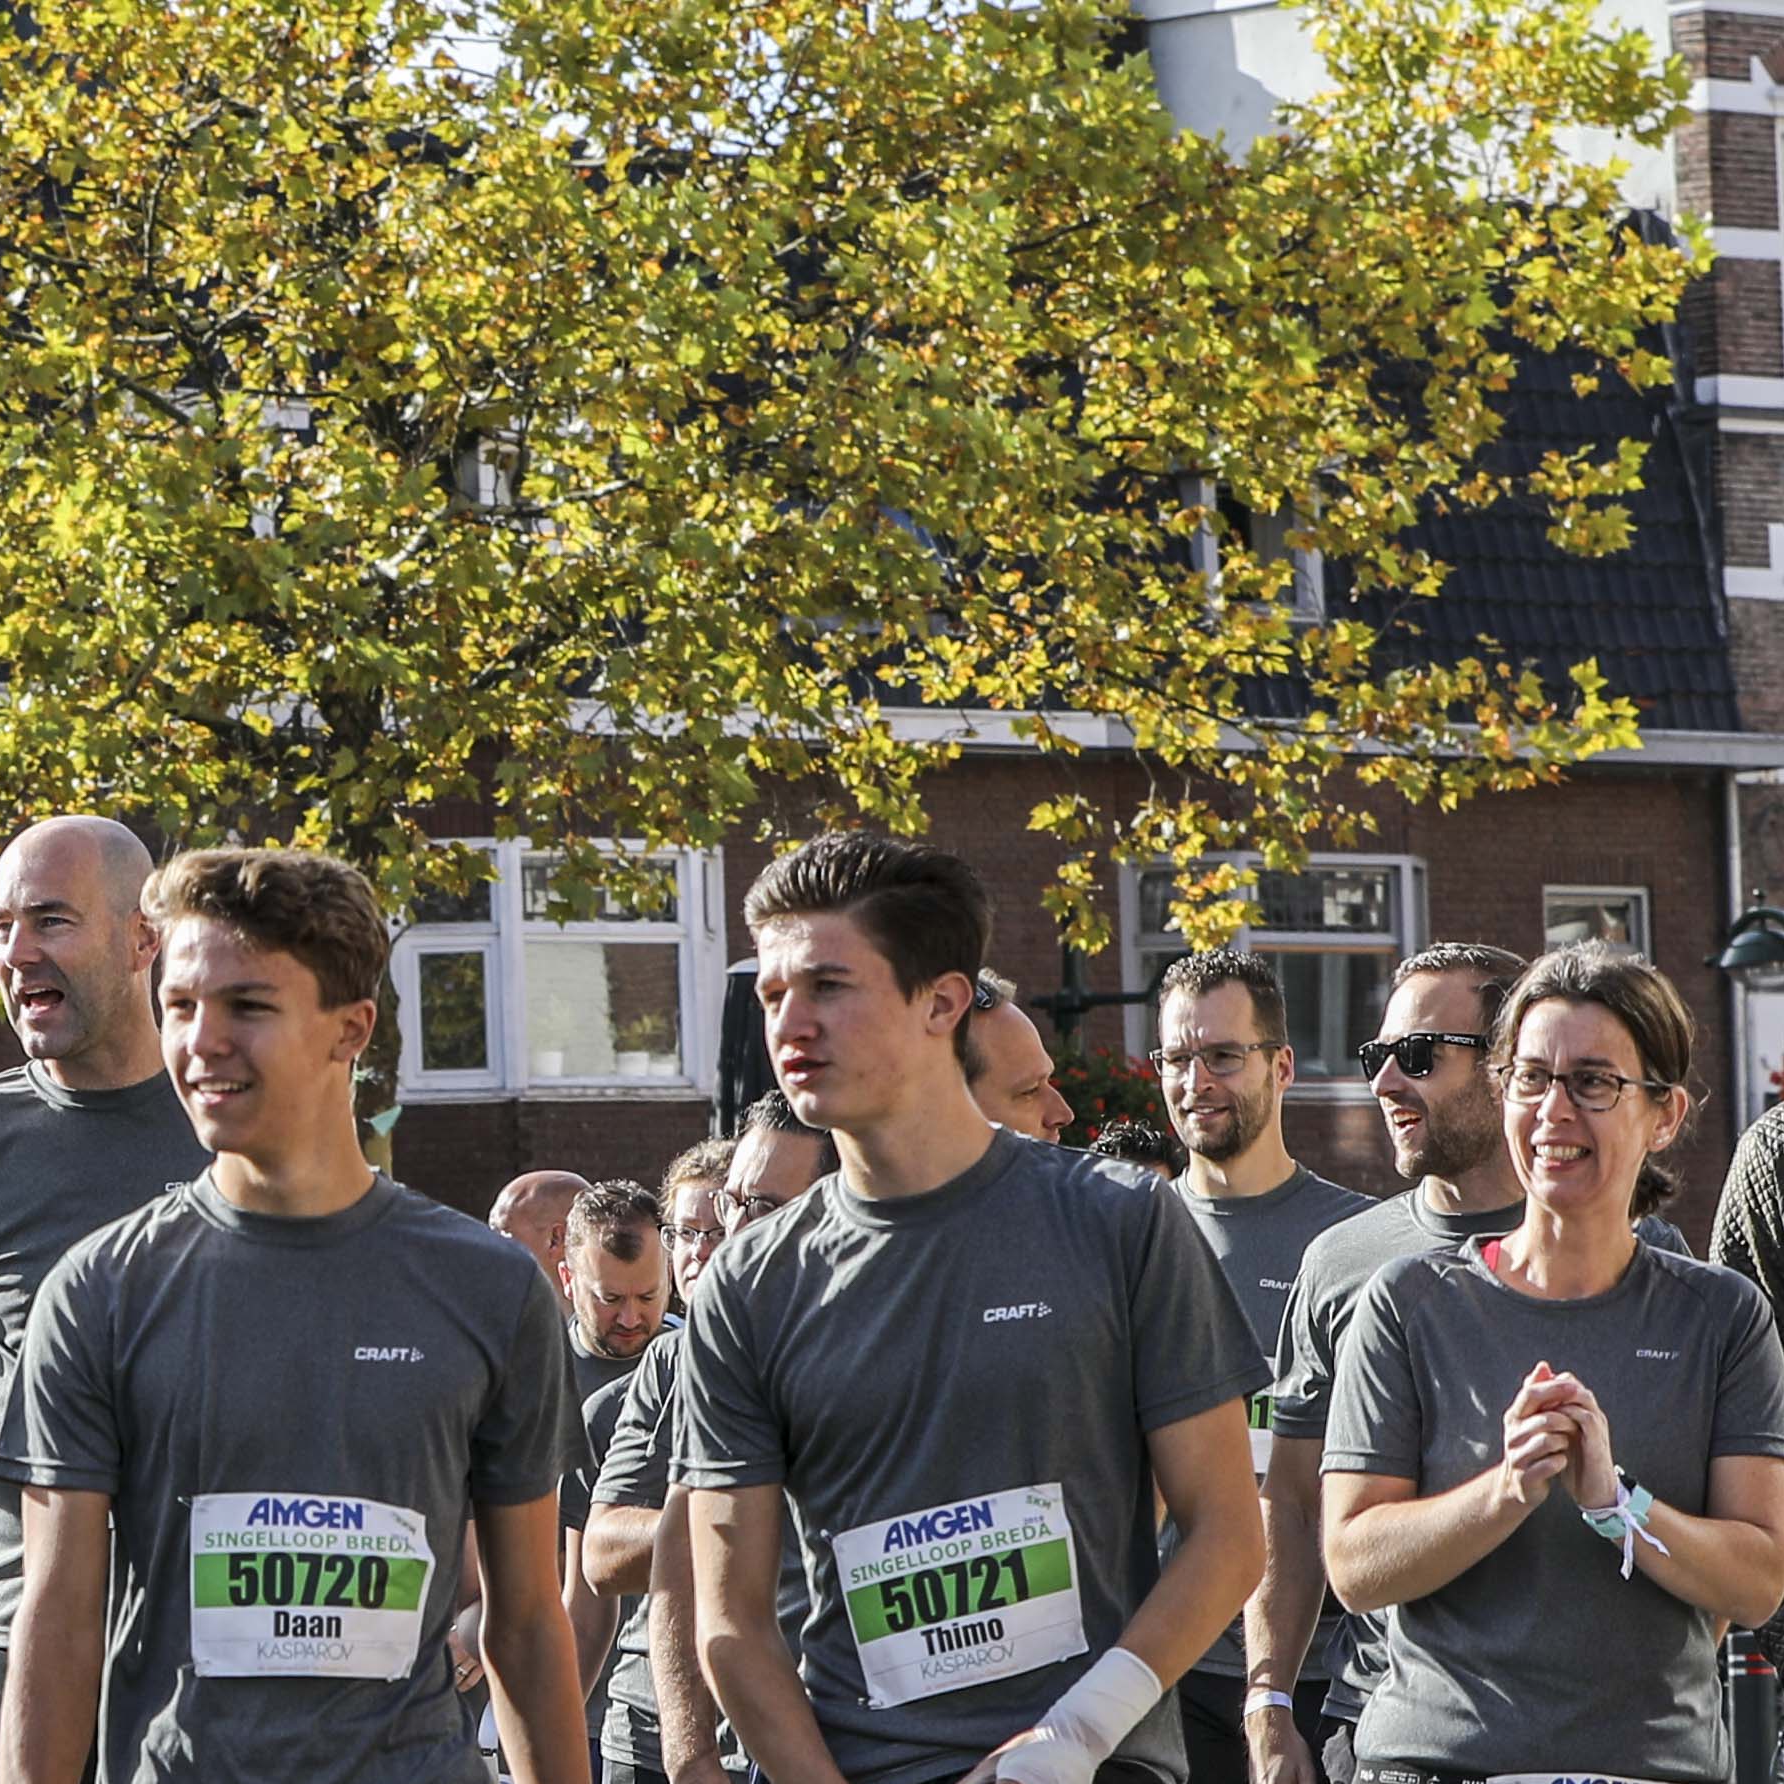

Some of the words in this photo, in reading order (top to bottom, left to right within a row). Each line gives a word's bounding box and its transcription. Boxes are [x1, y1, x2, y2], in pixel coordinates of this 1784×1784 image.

[983, 1304, 1037, 1322] CRAFT
[354, 1347, 409, 1361] CRAFT
[247, 1498, 363, 1530] AMGEN
[883, 1500, 994, 1553] AMGEN
[205, 1531, 337, 1549] SINGELLOOP
[850, 1539, 972, 1584] SINGELLOOP
[981, 1522, 1052, 1551] BREDA
[228, 1552, 389, 1609] 50720
[879, 1548, 1030, 1633] 50721
[274, 1611, 342, 1638] Daan
[920, 1618, 1004, 1656] Thimo
[257, 1642, 353, 1661] KASPAROV
[920, 1643, 1015, 1680] KASPAROV
